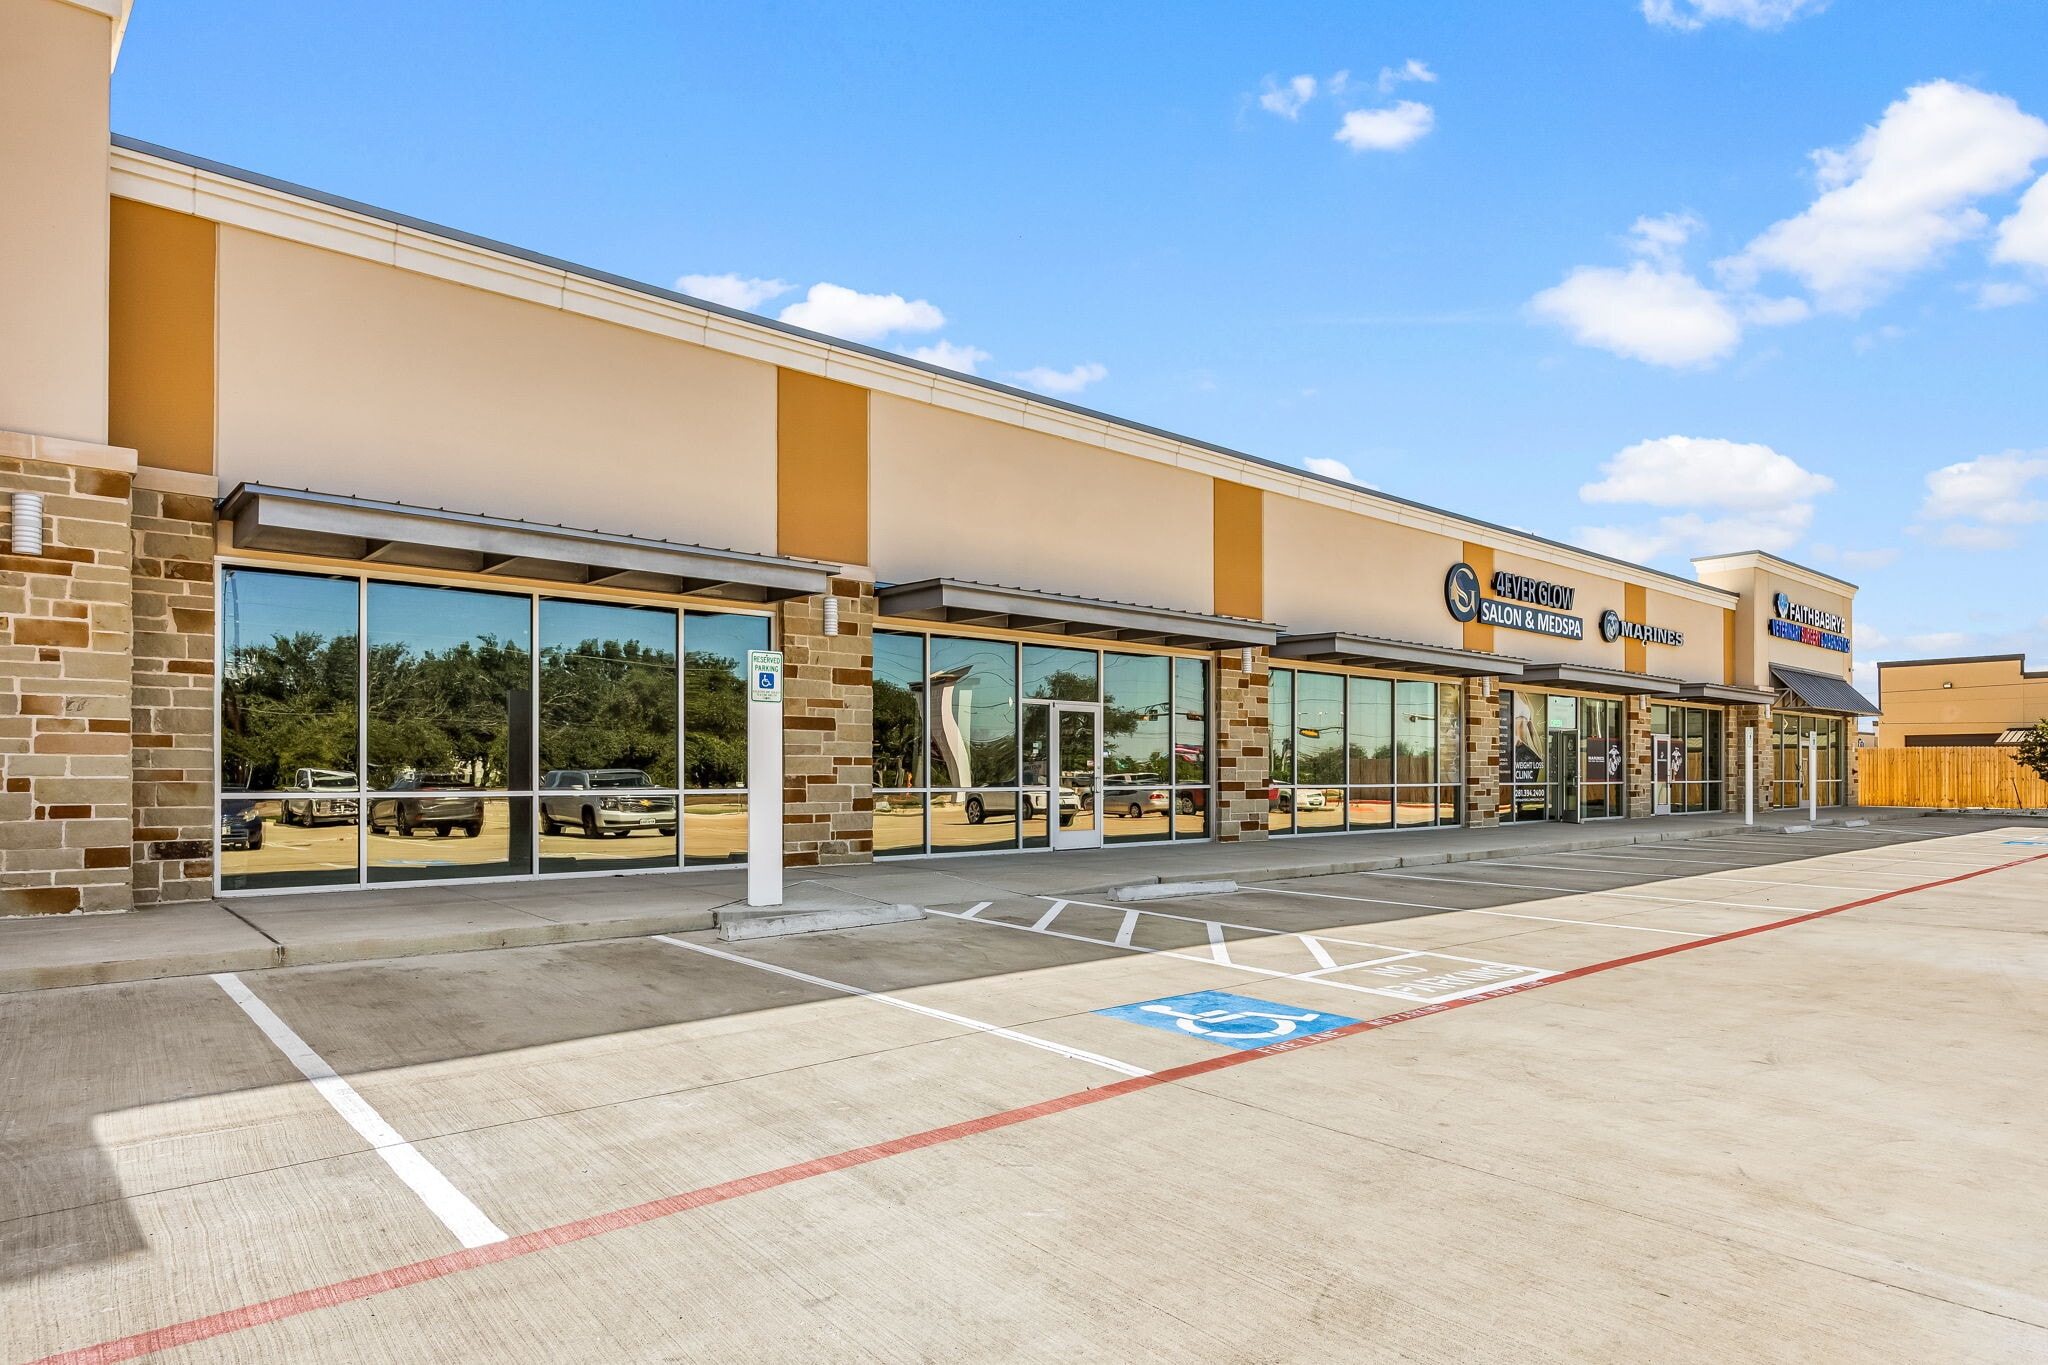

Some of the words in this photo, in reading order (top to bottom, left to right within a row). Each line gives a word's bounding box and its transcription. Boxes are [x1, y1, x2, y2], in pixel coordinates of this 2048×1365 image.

[1496, 571, 1536, 603] 4EVER
[1539, 581, 1575, 610] GLOW
[1482, 602, 1522, 626] SALON
[1525, 611, 1535, 629] &
[1538, 613, 1582, 637] MEDSPA
[1790, 603, 1845, 633] FAITHBABIRYE
[1621, 621, 1683, 646] MARINES
[754, 656, 780, 664] RESERVED
[755, 664, 778, 672] PARKING
[1515, 761, 1532, 769] WEIGHT
[1515, 770, 1533, 779] CLINIC
[1360, 964, 1428, 977] NO
[1378, 965, 1526, 997] PARKING
[1256, 1042, 1303, 1055] FIRE
[1301, 1030, 1346, 1045] LANE
[1366, 1017, 1393, 1027] NO
[1389, 1004, 1450, 1021] PARKING
